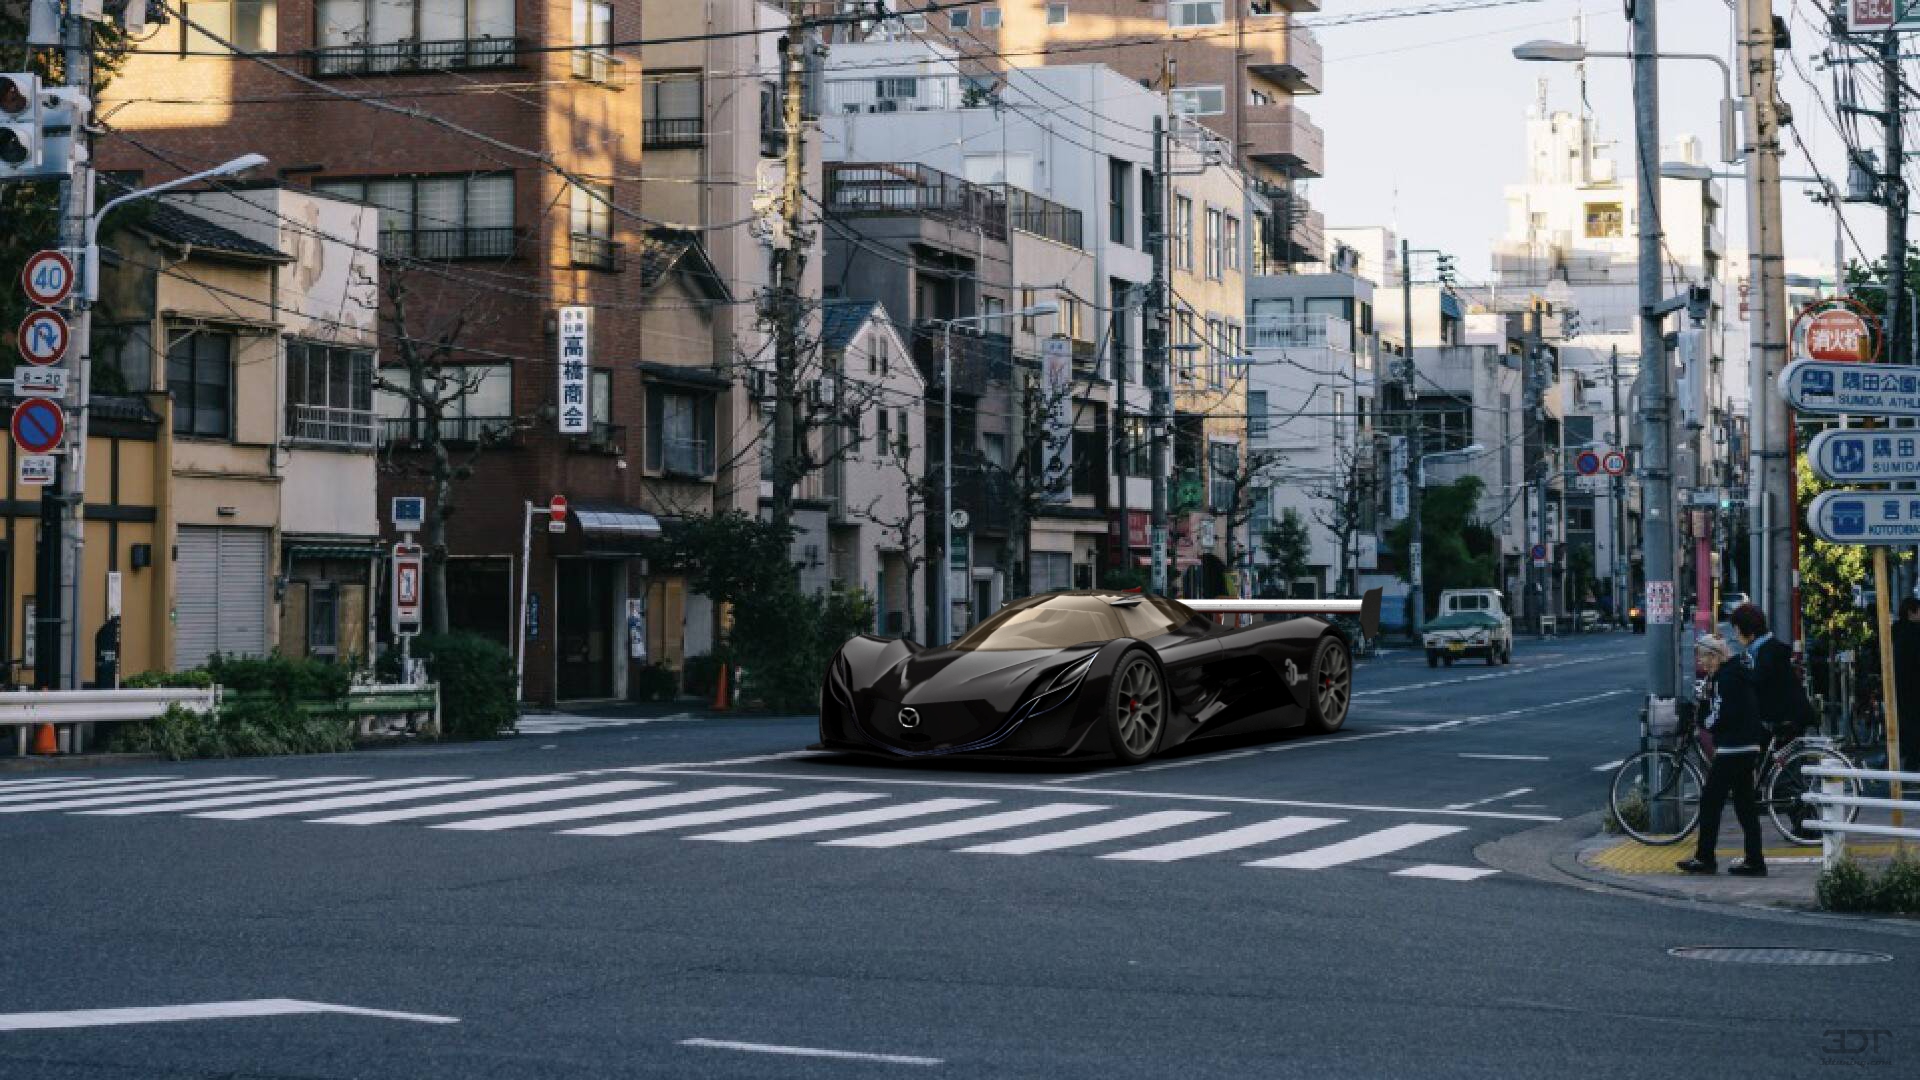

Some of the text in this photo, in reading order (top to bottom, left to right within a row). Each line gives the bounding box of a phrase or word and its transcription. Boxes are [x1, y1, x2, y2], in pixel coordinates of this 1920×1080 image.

[34, 267, 62, 290] 40
[563, 335, 584, 427] 高橋商会
[1839, 394, 1920, 408] SUMIDA ATHL
